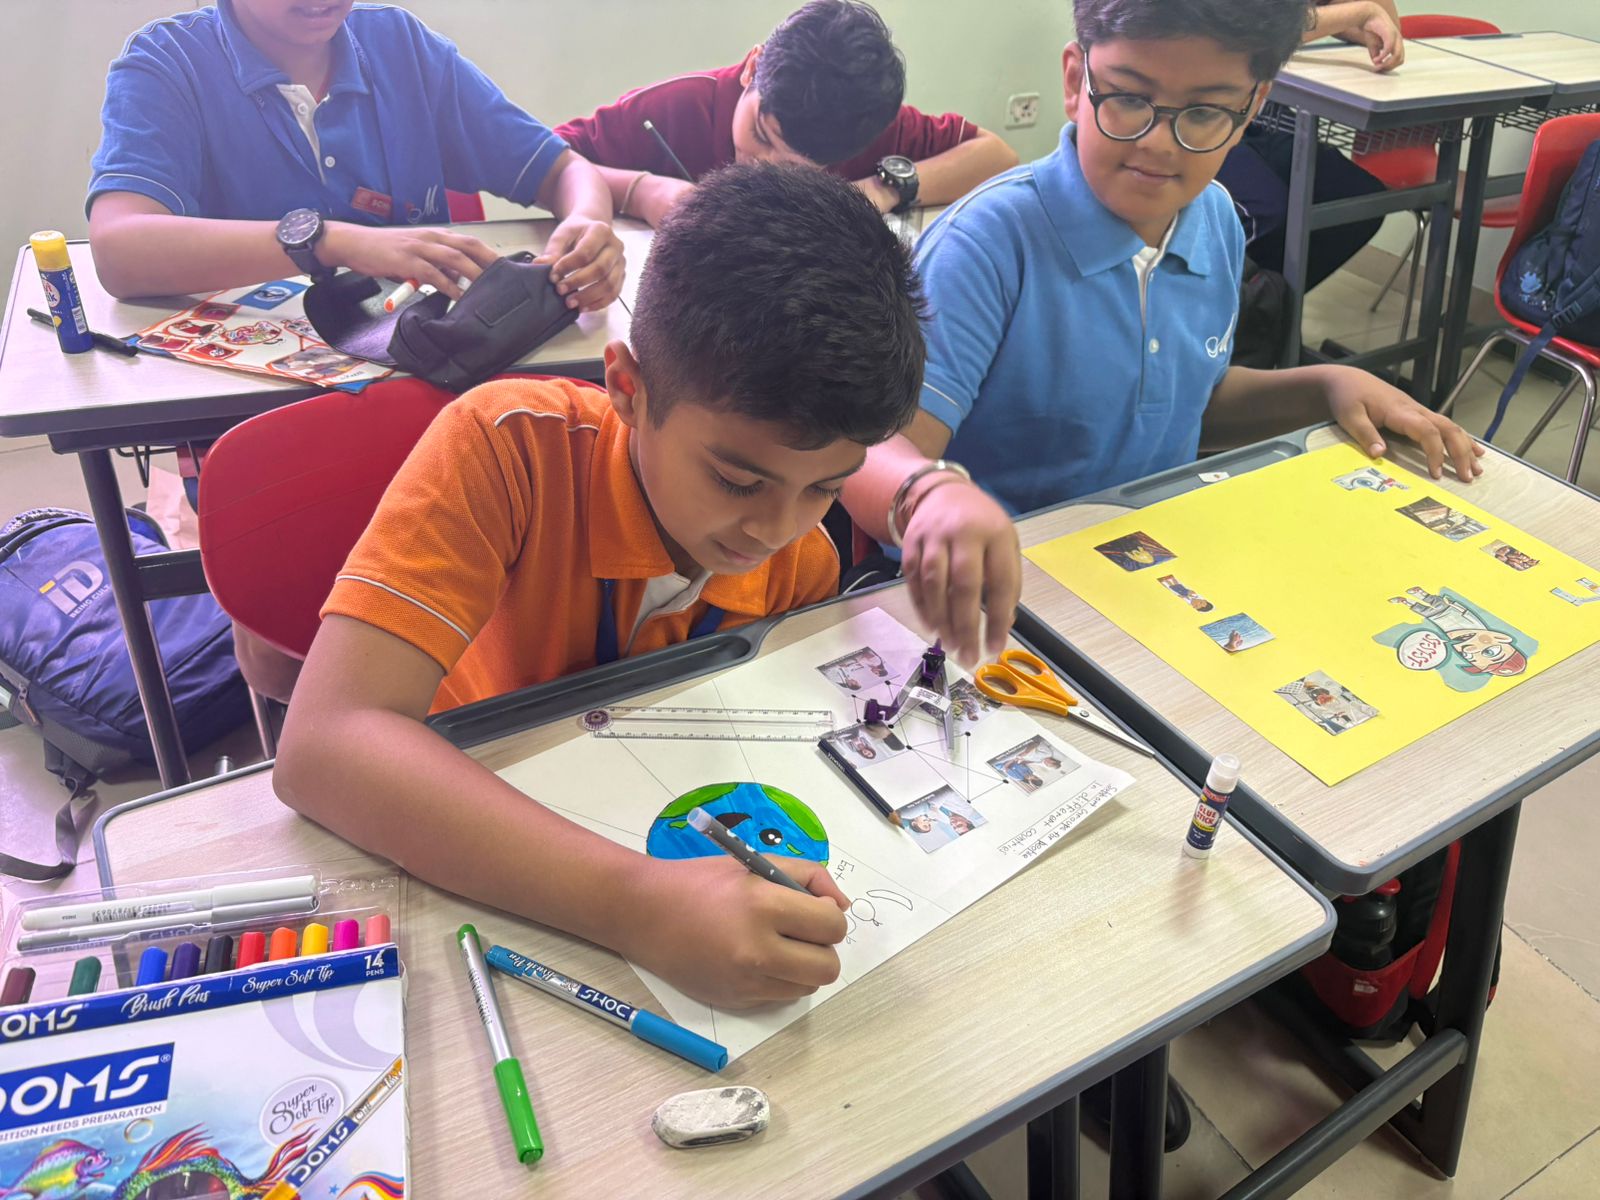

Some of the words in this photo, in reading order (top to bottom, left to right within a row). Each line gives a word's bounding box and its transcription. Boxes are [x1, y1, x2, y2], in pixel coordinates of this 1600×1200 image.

[69, 600, 92, 619] BEING
[92, 584, 110, 601] CULT
[1196, 811, 1215, 825] STICK
[1199, 805, 1217, 819] GLUE
[833, 859, 855, 881] Eat
[364, 949, 385, 970] 14
[365, 969, 385, 977] PENS
[121, 986, 179, 1019] Brush
[177, 984, 211, 1008] Pens
[242, 975, 283, 995] Super
[285, 966, 314, 988] Soft
[314, 964, 335, 984] Tip
[580, 989, 631, 1018] DOMS
[1, 1003, 83, 1038] OMS
[0, 1055, 159, 1116] OMS
[41, 1121, 79, 1134] NEEDS
[82, 1104, 162, 1127] PREPARATION
[291, 1121, 349, 1183] DOMS
